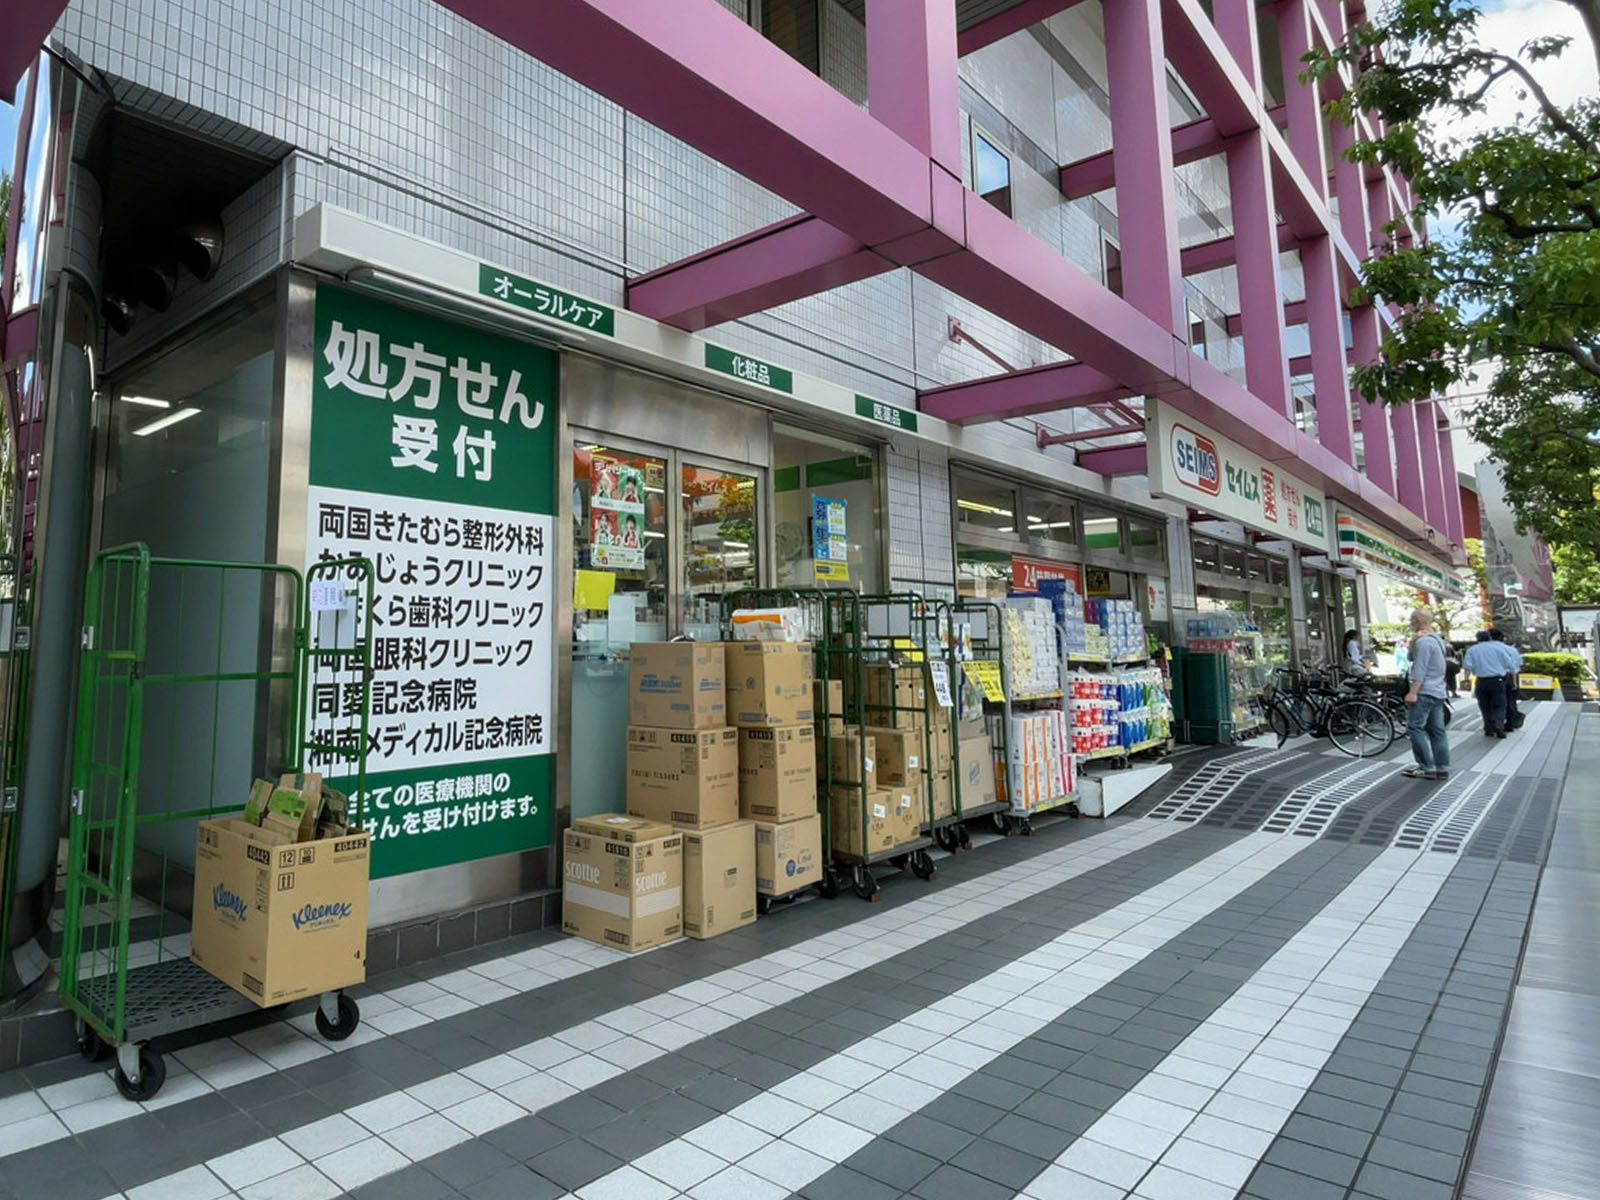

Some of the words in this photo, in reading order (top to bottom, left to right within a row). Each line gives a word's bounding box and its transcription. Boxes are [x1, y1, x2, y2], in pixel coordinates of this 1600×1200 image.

[494, 276, 603, 327] オーラルケア
[323, 320, 544, 429] 処方せん
[732, 355, 771, 385] 化粧品
[873, 402, 901, 427] 医薬品
[390, 414, 496, 481] 受付
[1176, 439, 1216, 481] SEIMS
[319, 502, 544, 556] 両国きたむら整形外科
[282, 852, 294, 863] 12
[292, 902, 352, 930] Kleenex
